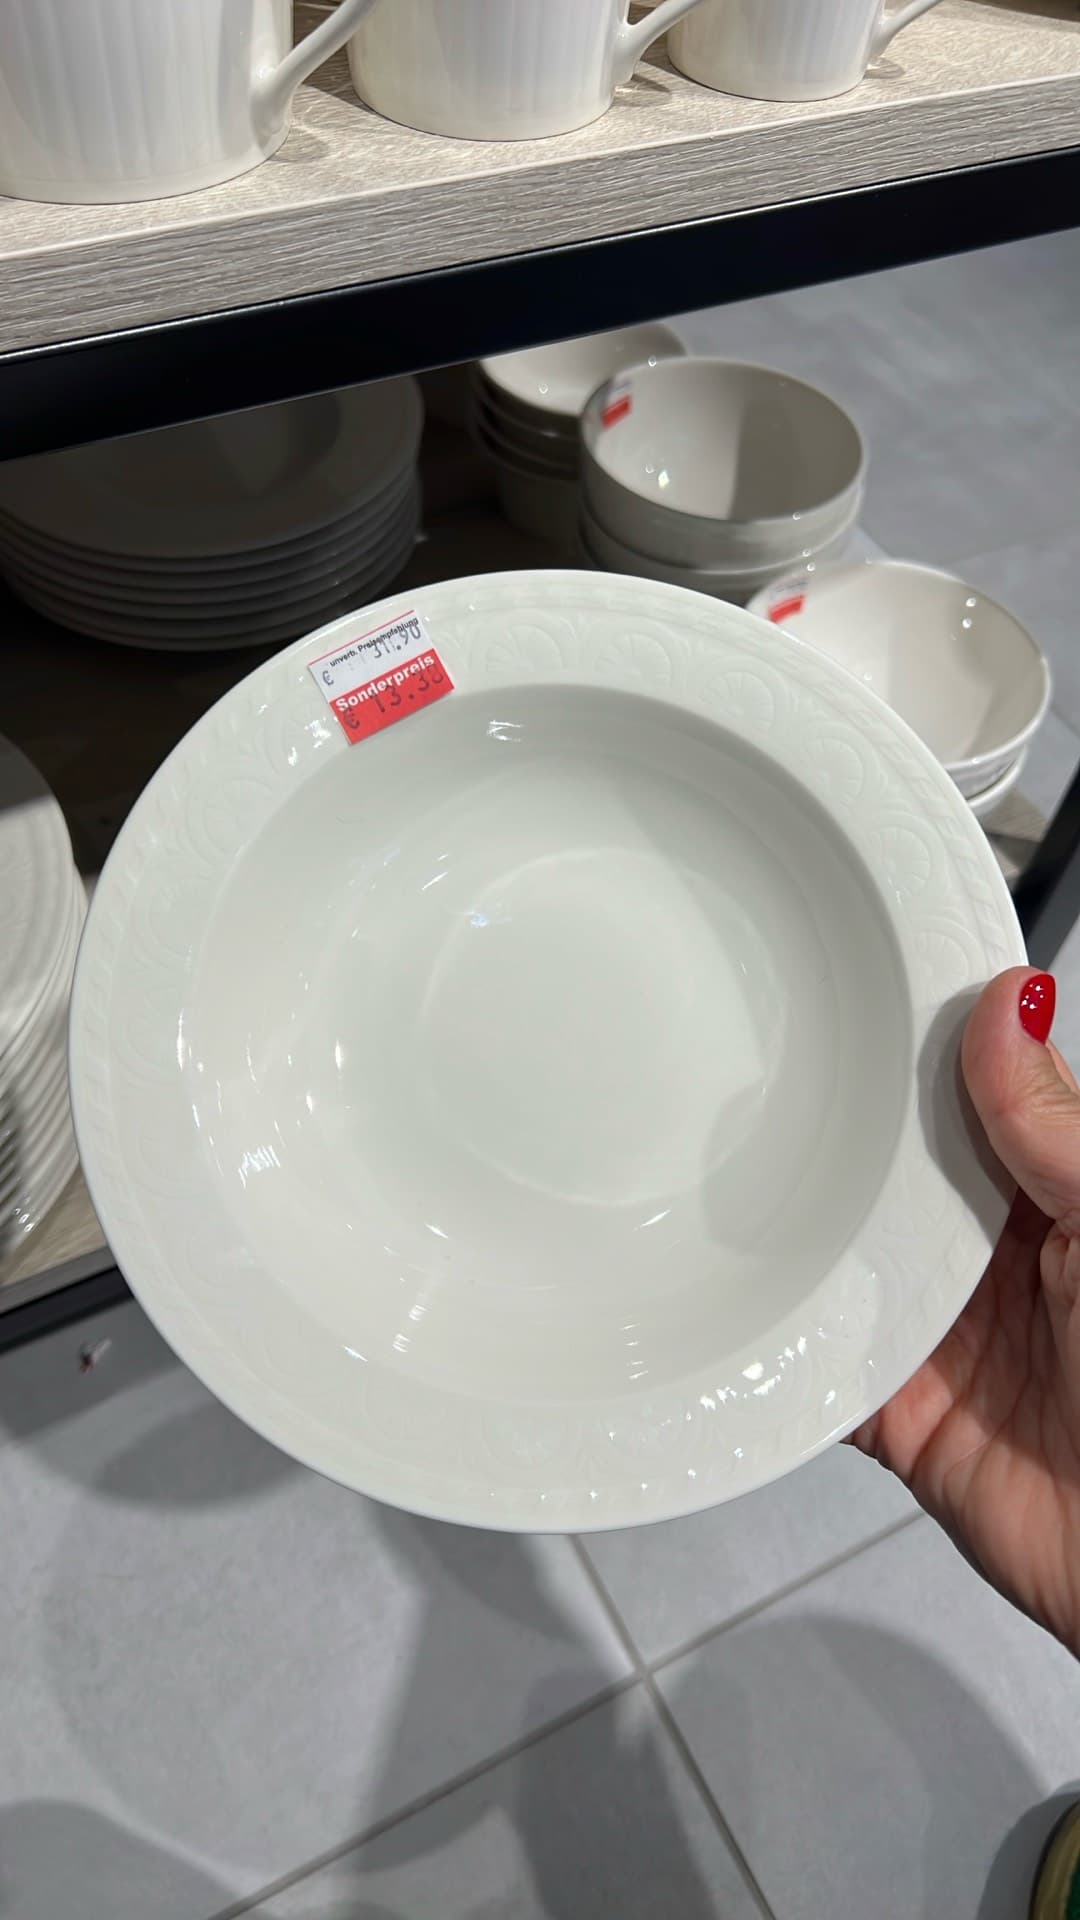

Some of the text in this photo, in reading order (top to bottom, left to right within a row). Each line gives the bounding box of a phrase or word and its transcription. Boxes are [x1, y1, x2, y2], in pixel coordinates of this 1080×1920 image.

[329, 649, 357, 668] unverb.
[322, 670, 335, 686] €
[336, 654, 435, 712] Sonderpreis
